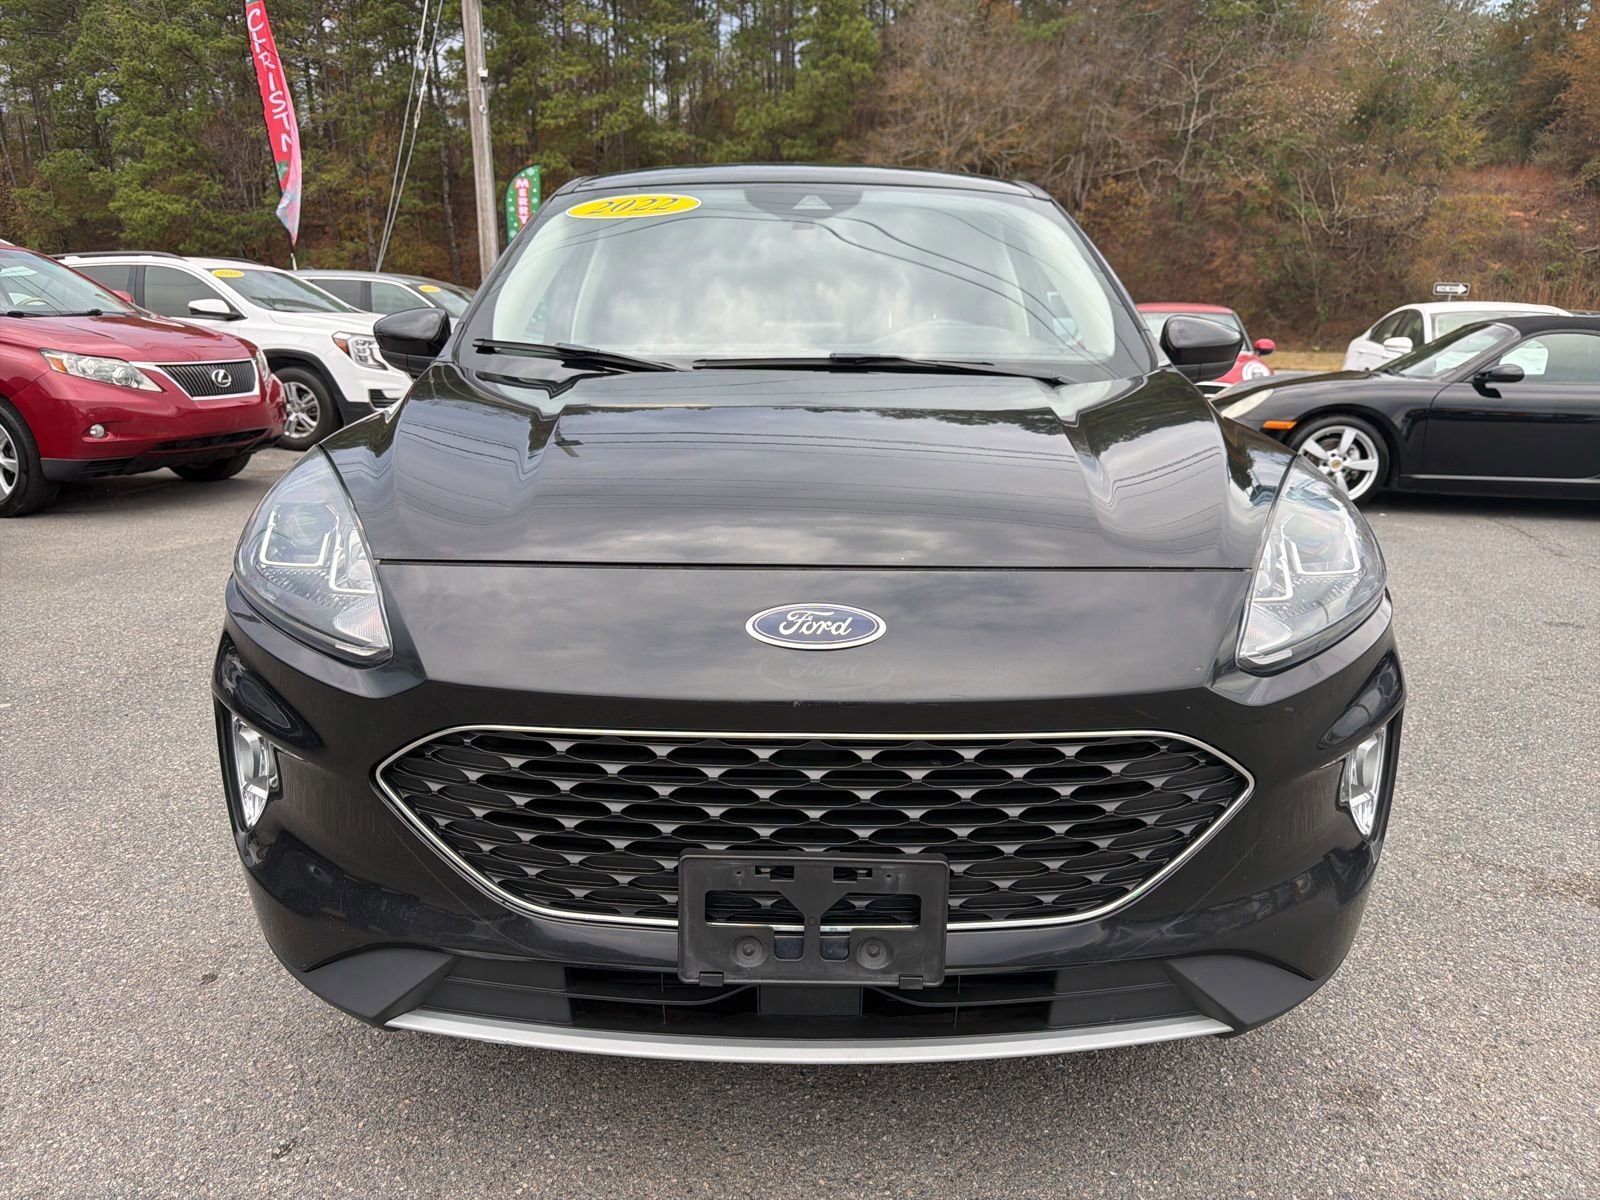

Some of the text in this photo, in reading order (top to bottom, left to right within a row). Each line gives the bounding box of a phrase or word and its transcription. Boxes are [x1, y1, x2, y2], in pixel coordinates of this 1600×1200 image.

[514, 178, 530, 225] MERRY
[585, 197, 679, 215] 2022
[778, 610, 852, 636] Ford
